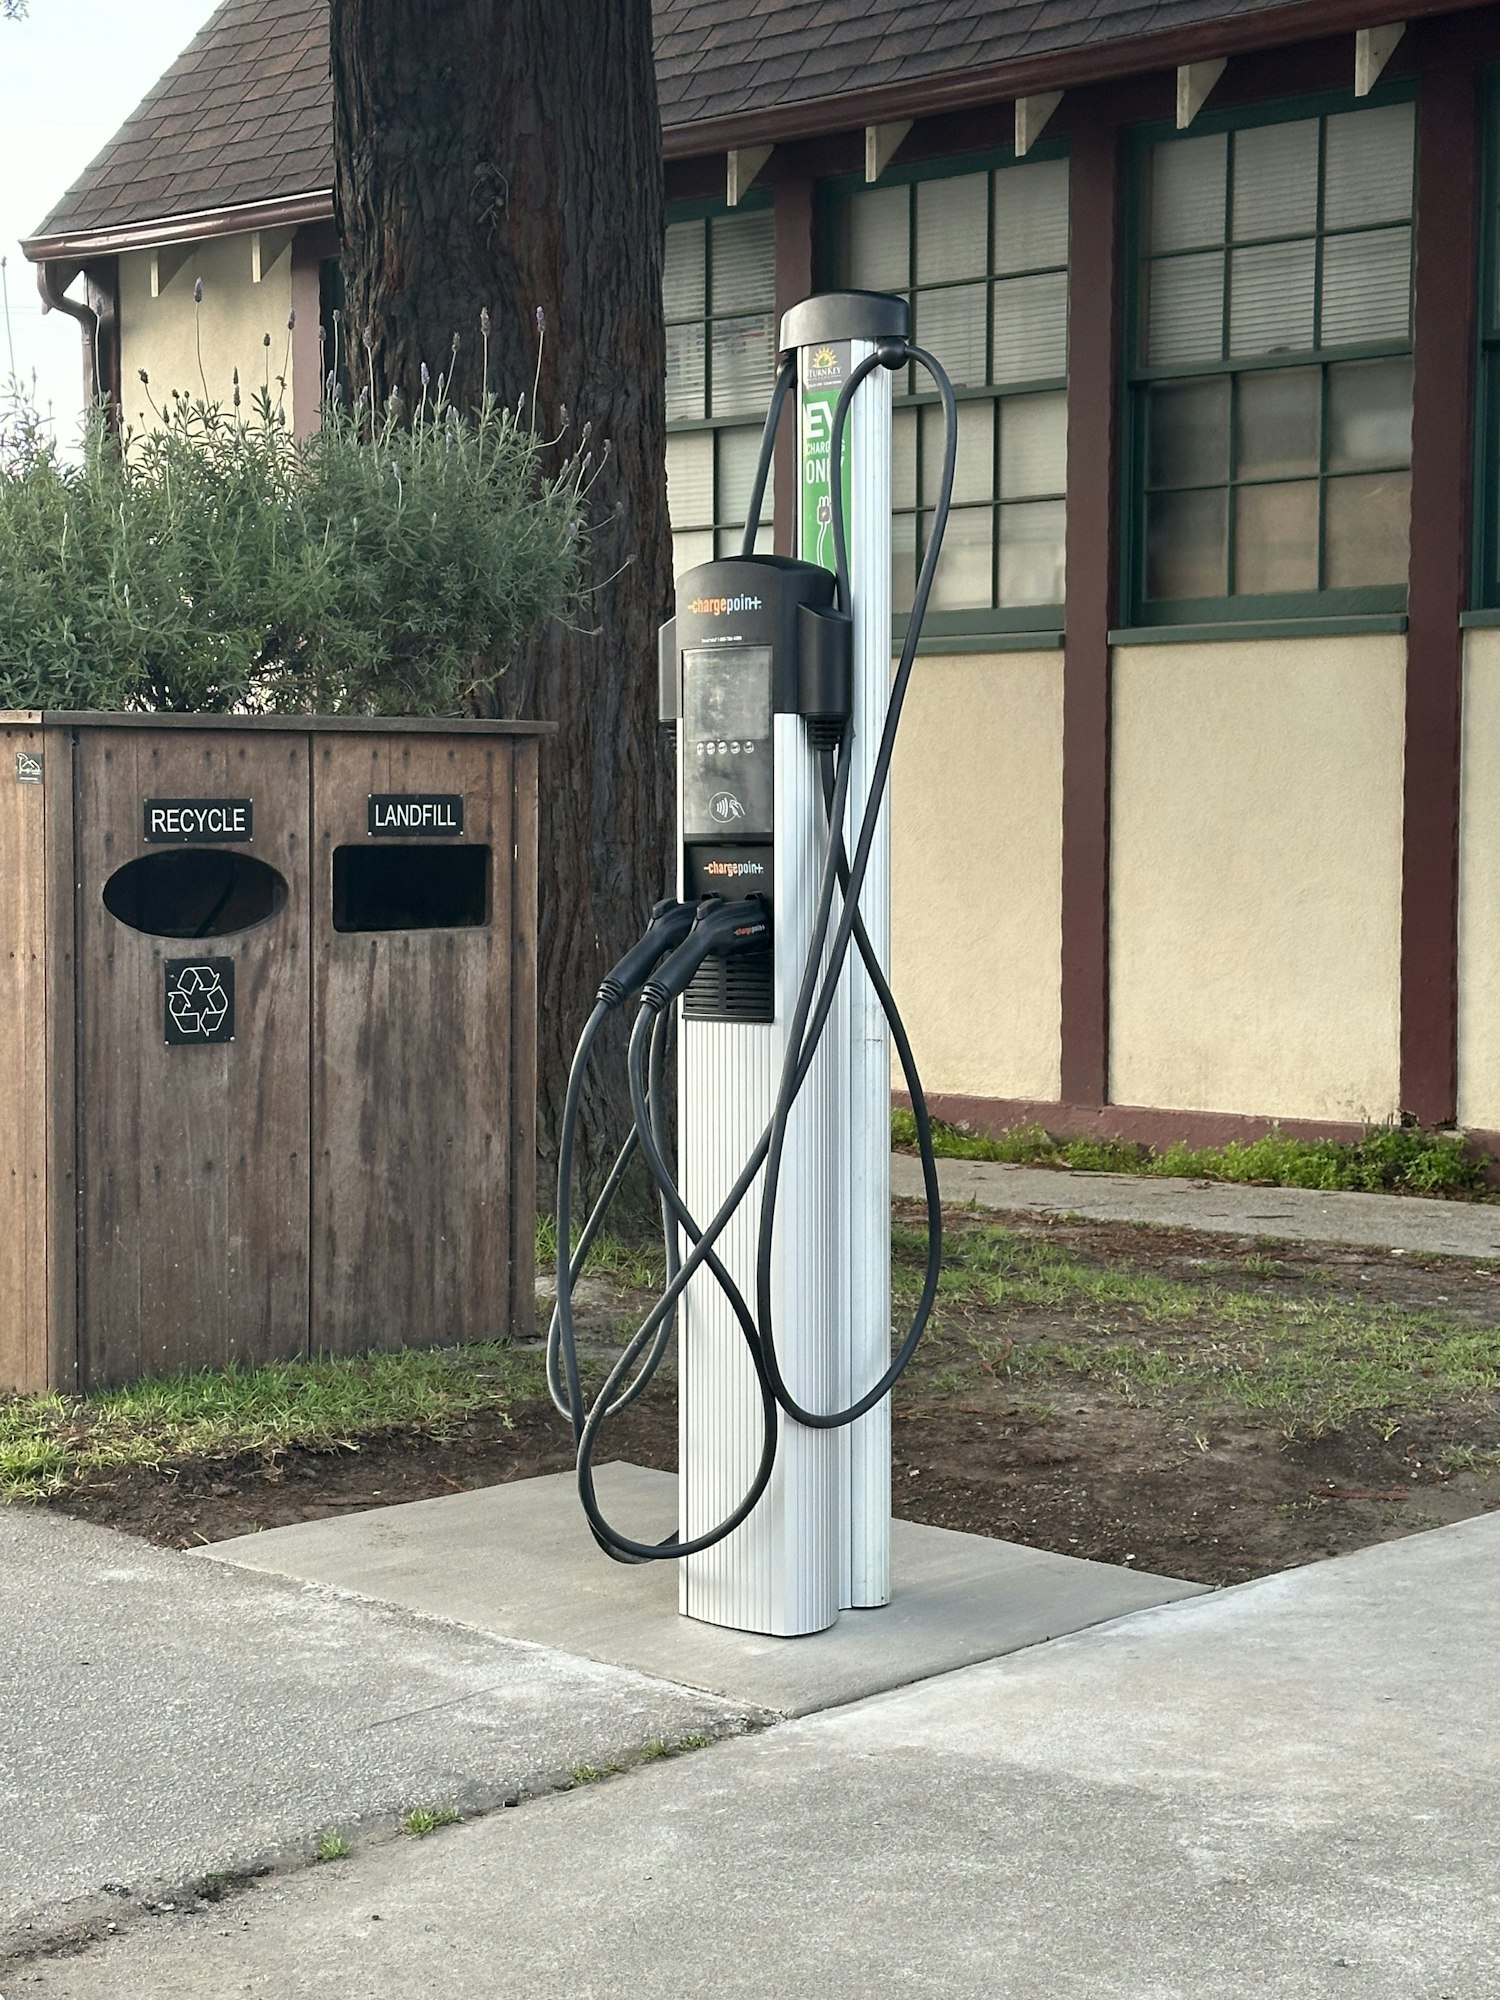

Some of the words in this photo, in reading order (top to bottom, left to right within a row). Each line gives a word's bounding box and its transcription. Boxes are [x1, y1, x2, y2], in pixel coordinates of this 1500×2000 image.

[806, 439, 846, 456] CHARGG
[151, 808, 246, 833] RECYCLE
[375, 804, 457, 827] LANDFILL
